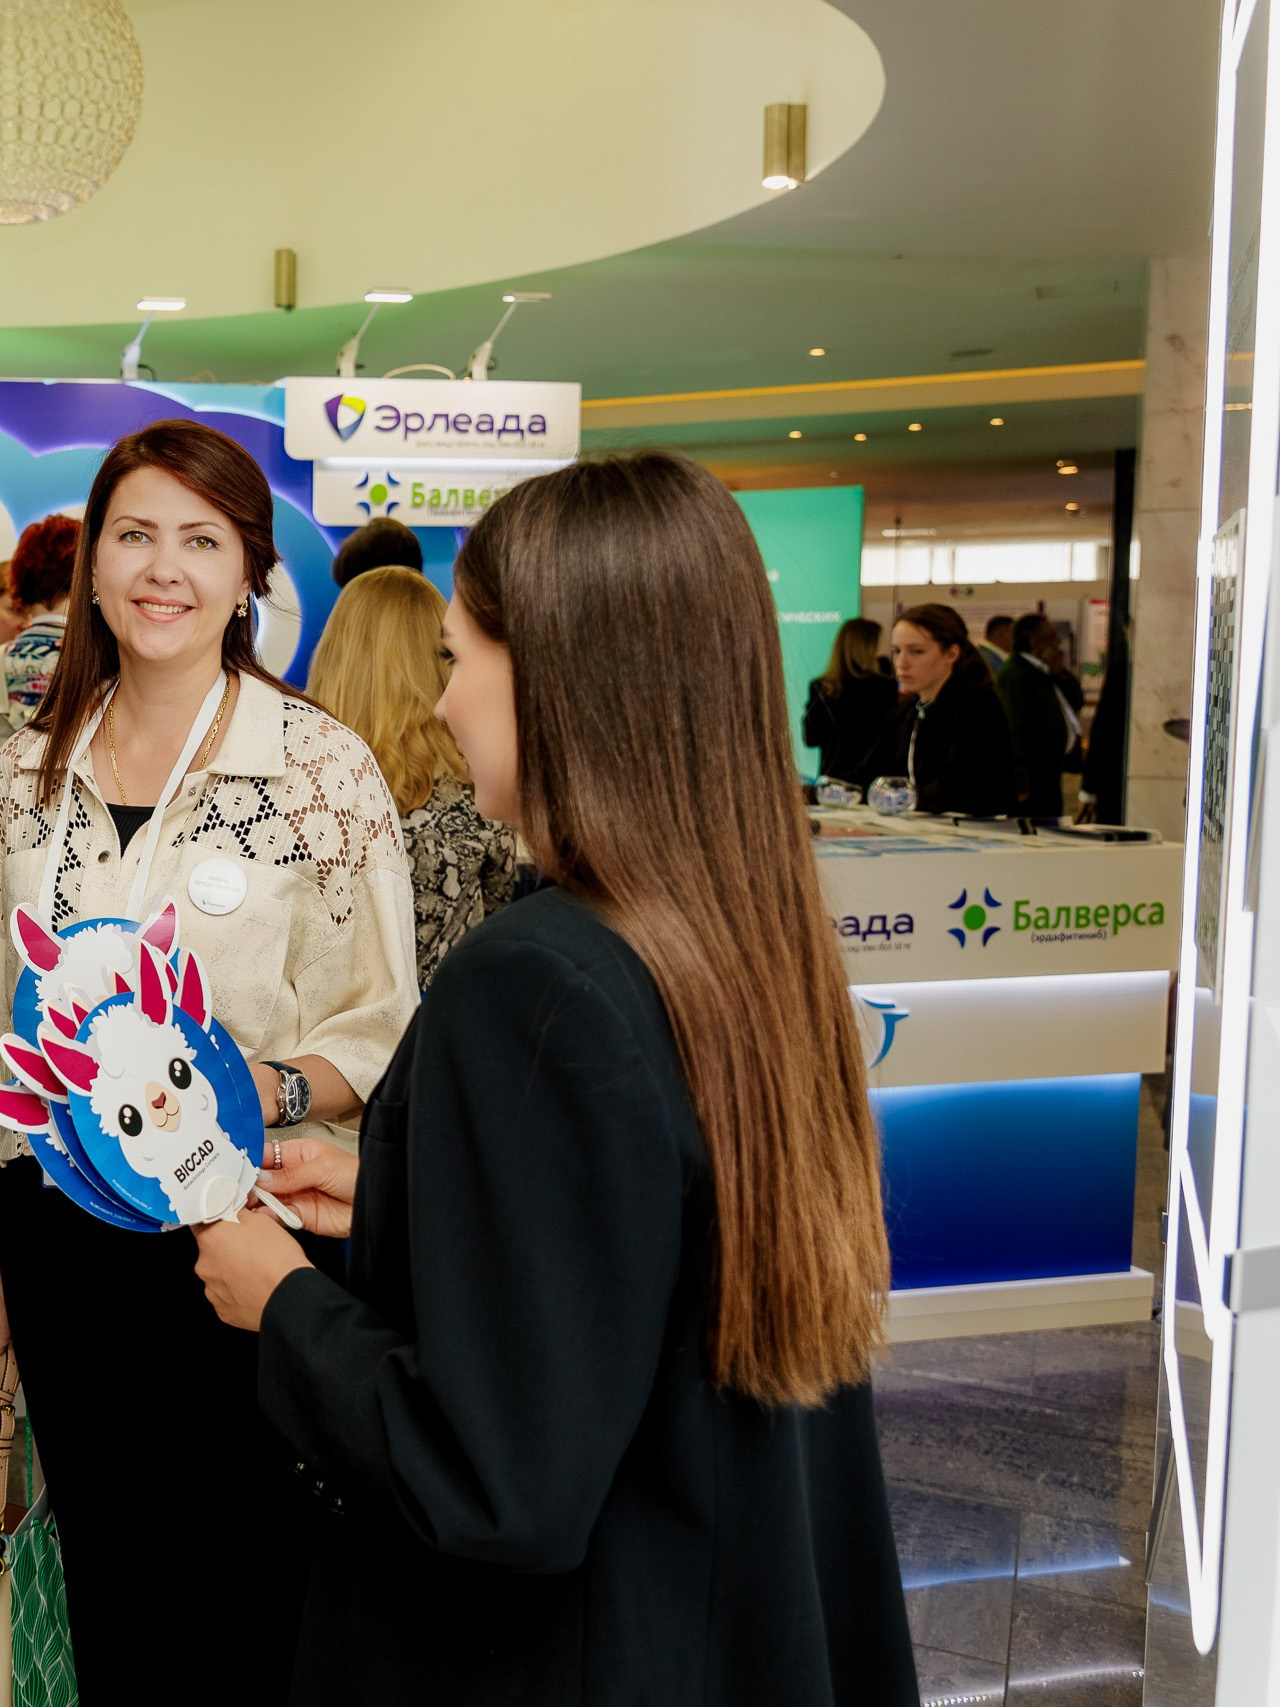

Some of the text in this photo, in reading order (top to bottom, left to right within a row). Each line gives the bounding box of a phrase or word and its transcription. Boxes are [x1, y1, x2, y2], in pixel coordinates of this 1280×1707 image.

[375, 404, 547, 440] Эрлеада
[411, 482, 500, 508] Балве
[831, 913, 914, 941] ада
[1013, 900, 1164, 935] Балверса
